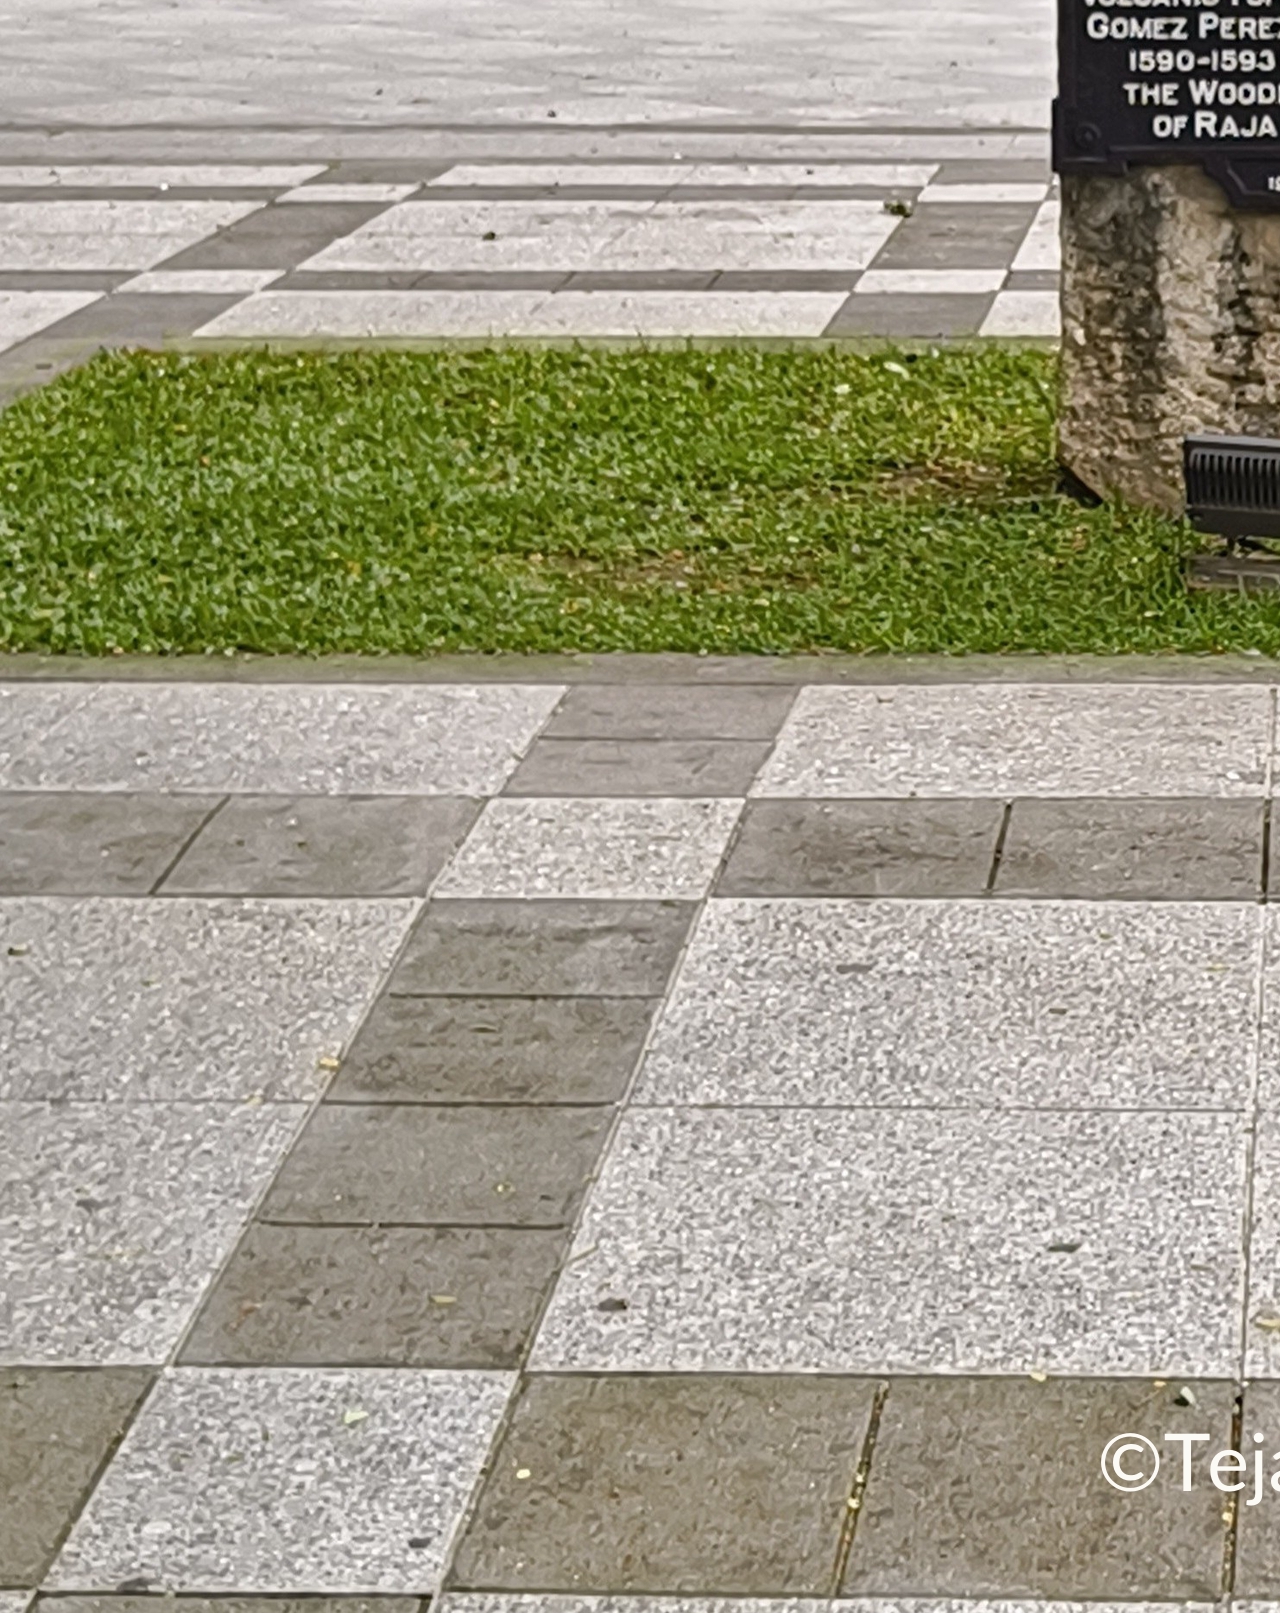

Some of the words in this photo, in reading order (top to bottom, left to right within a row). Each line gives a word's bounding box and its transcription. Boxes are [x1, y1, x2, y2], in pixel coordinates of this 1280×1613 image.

[1086, 10, 1189, 40] GOMEZ
[1128, 47, 1276, 73] 1590-1593
[1122, 78, 1179, 106] THE
[1152, 110, 1188, 139] OF
[1193, 110, 1278, 139] RAJA
